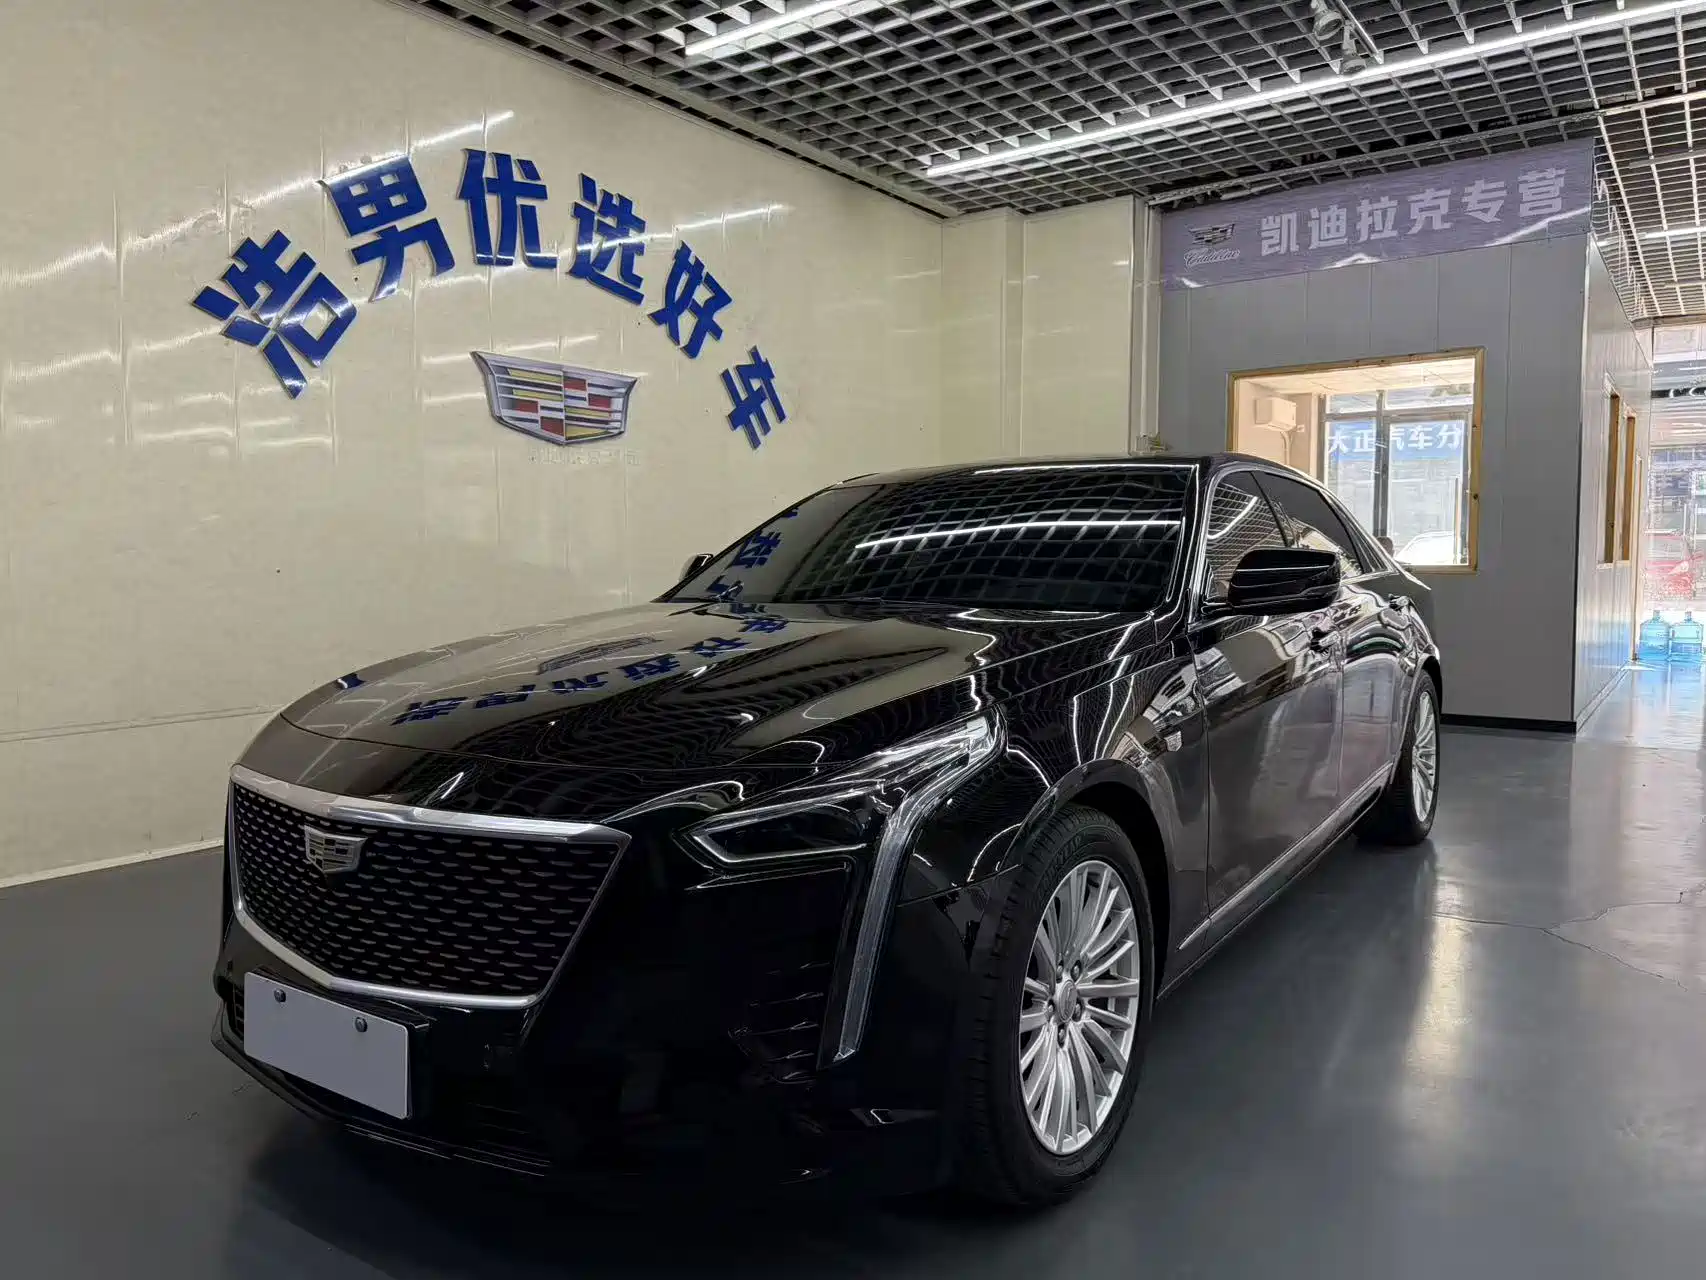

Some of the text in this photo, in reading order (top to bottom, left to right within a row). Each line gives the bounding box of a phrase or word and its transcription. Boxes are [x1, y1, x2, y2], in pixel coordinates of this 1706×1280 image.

[192, 148, 788, 450] 浩男优选好车
[1260, 167, 1566, 257] 凯迪拉克专营
